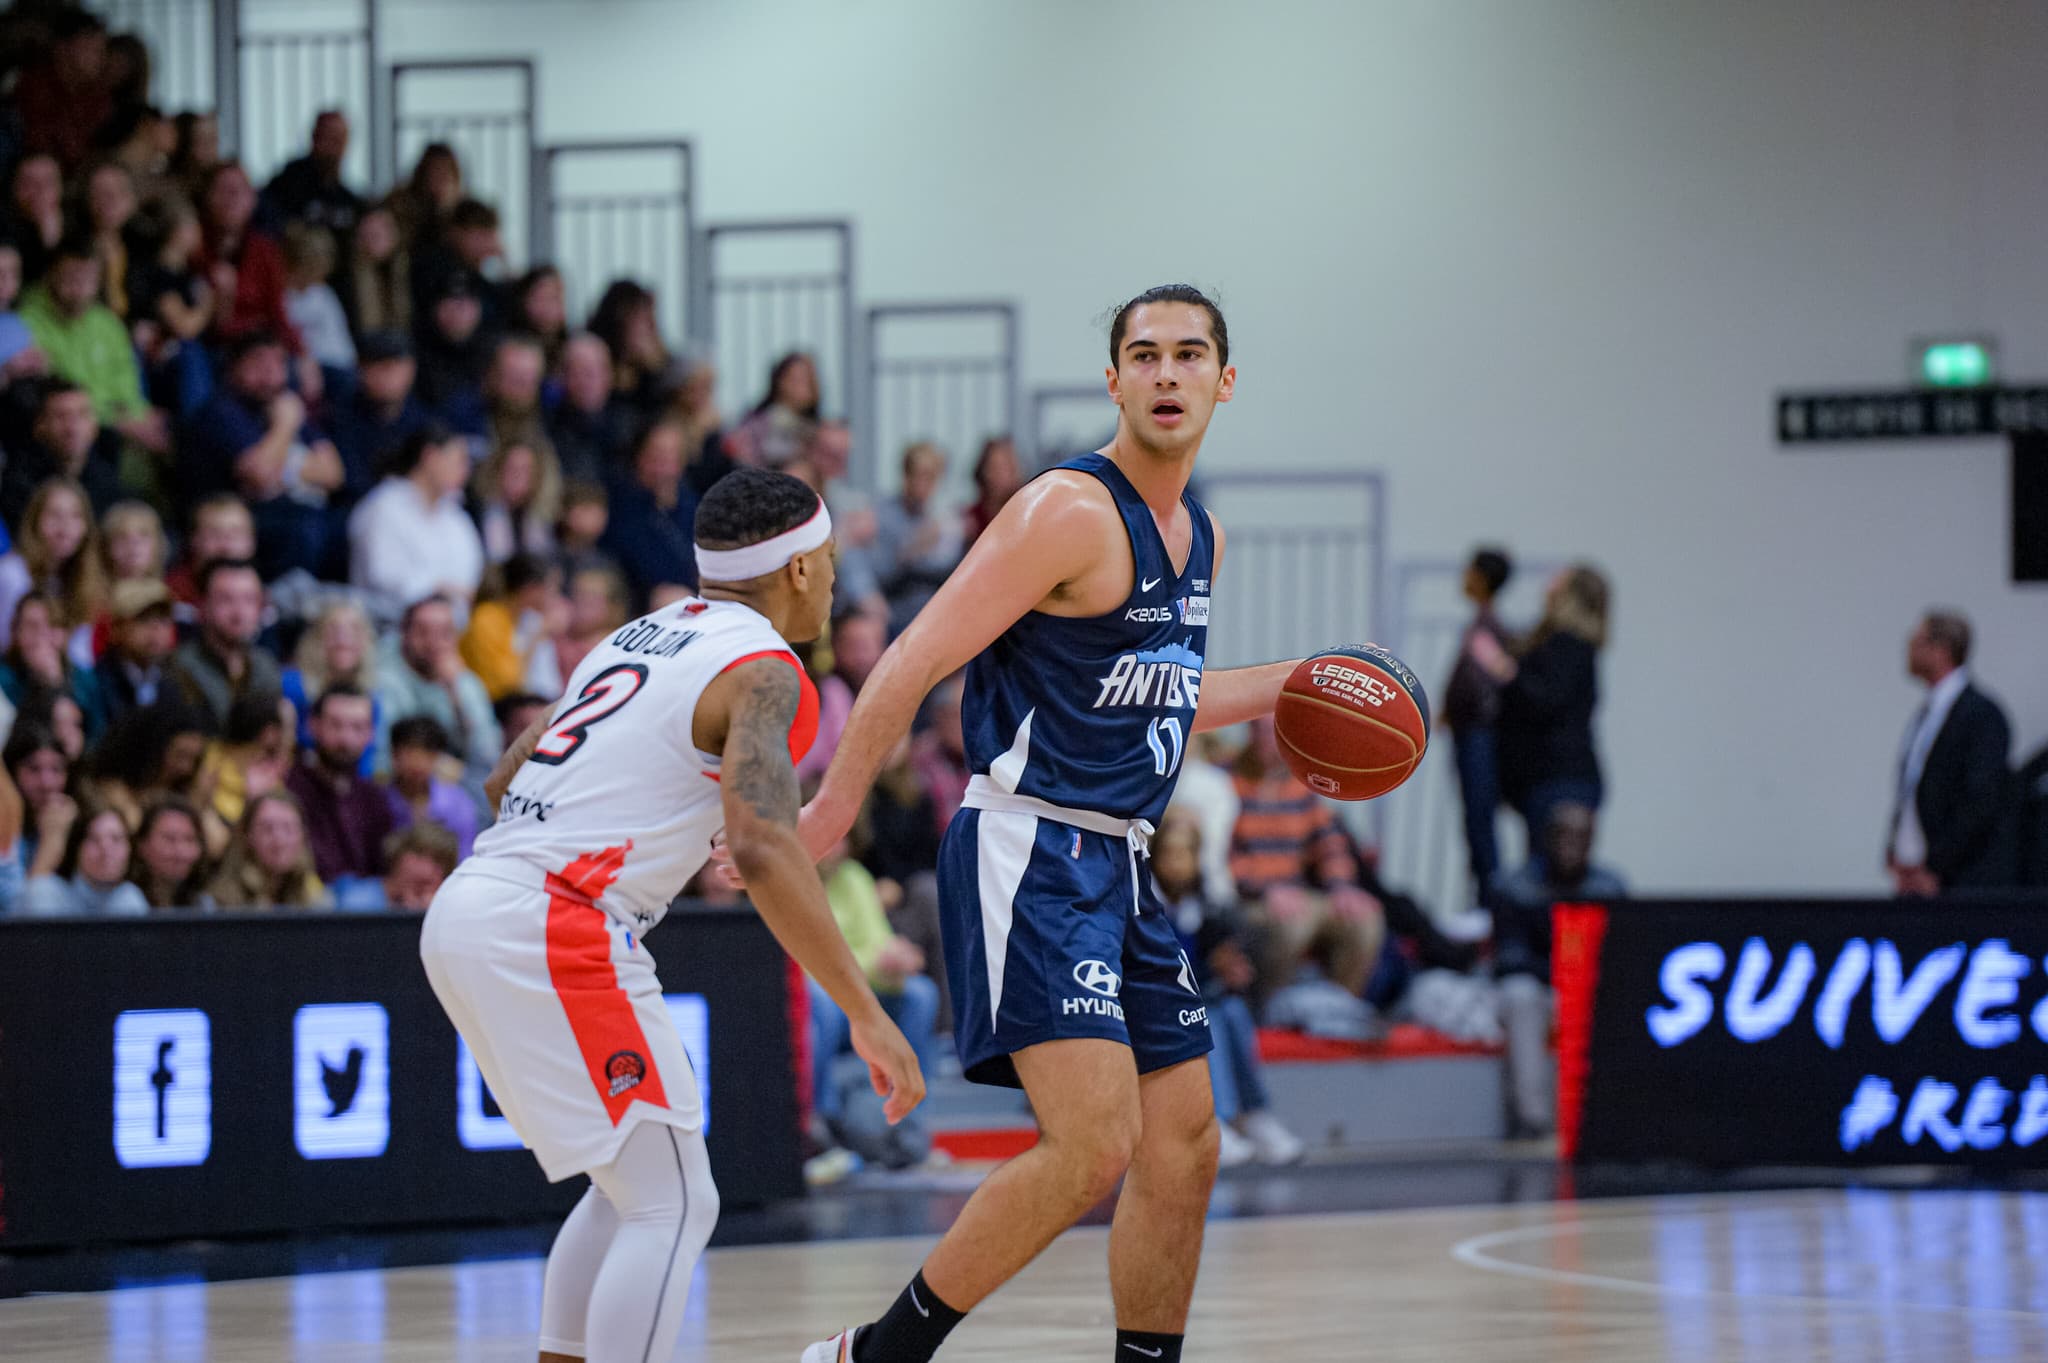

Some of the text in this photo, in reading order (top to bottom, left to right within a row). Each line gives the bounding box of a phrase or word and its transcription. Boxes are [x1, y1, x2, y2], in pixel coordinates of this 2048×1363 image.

[1310, 662, 1397, 701] LEGACY
[1330, 679, 1383, 707] 1000
[528, 663, 649, 766] 2
[1645, 935, 2048, 1049] SUIVE
[1063, 997, 1125, 1022] HYUND
[1178, 1006, 1207, 1026] Carr
